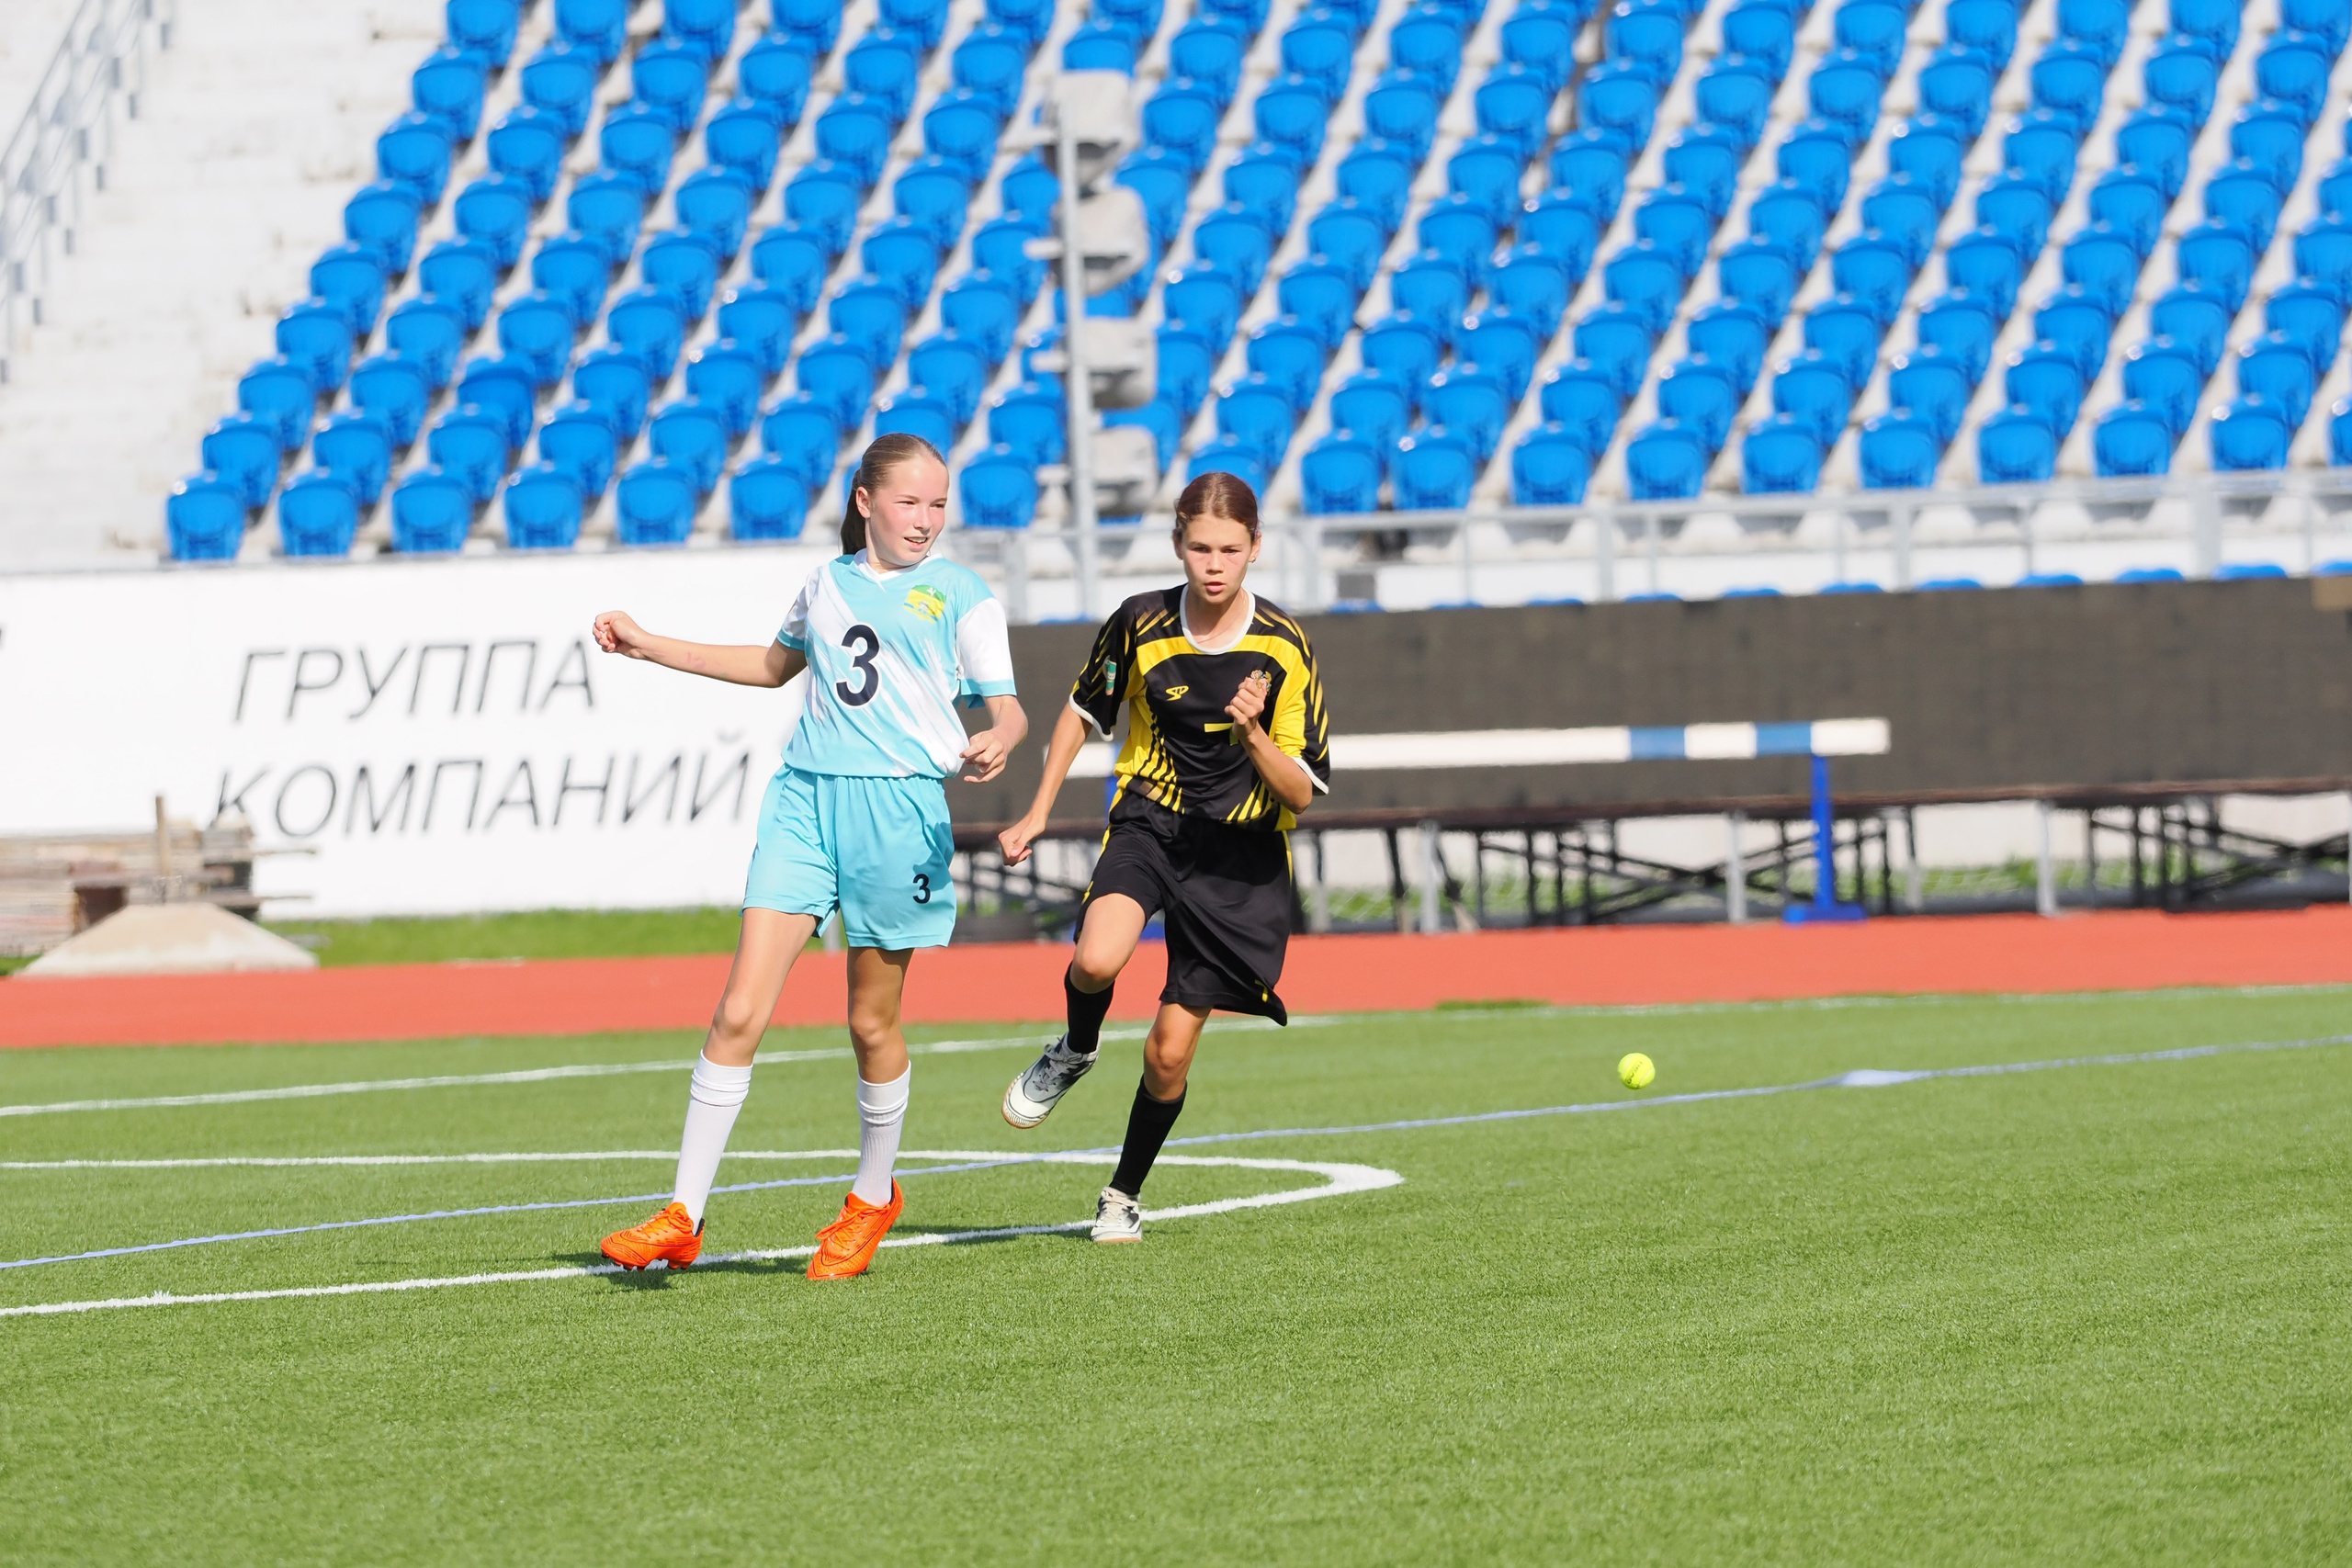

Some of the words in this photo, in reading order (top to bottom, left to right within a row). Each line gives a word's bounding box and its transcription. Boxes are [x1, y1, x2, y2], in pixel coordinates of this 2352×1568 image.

[234, 638, 595, 722] ГРУППА
[836, 624, 879, 706] 3
[217, 730, 752, 837] КОМПАНИЙ
[912, 873, 931, 905] 3
